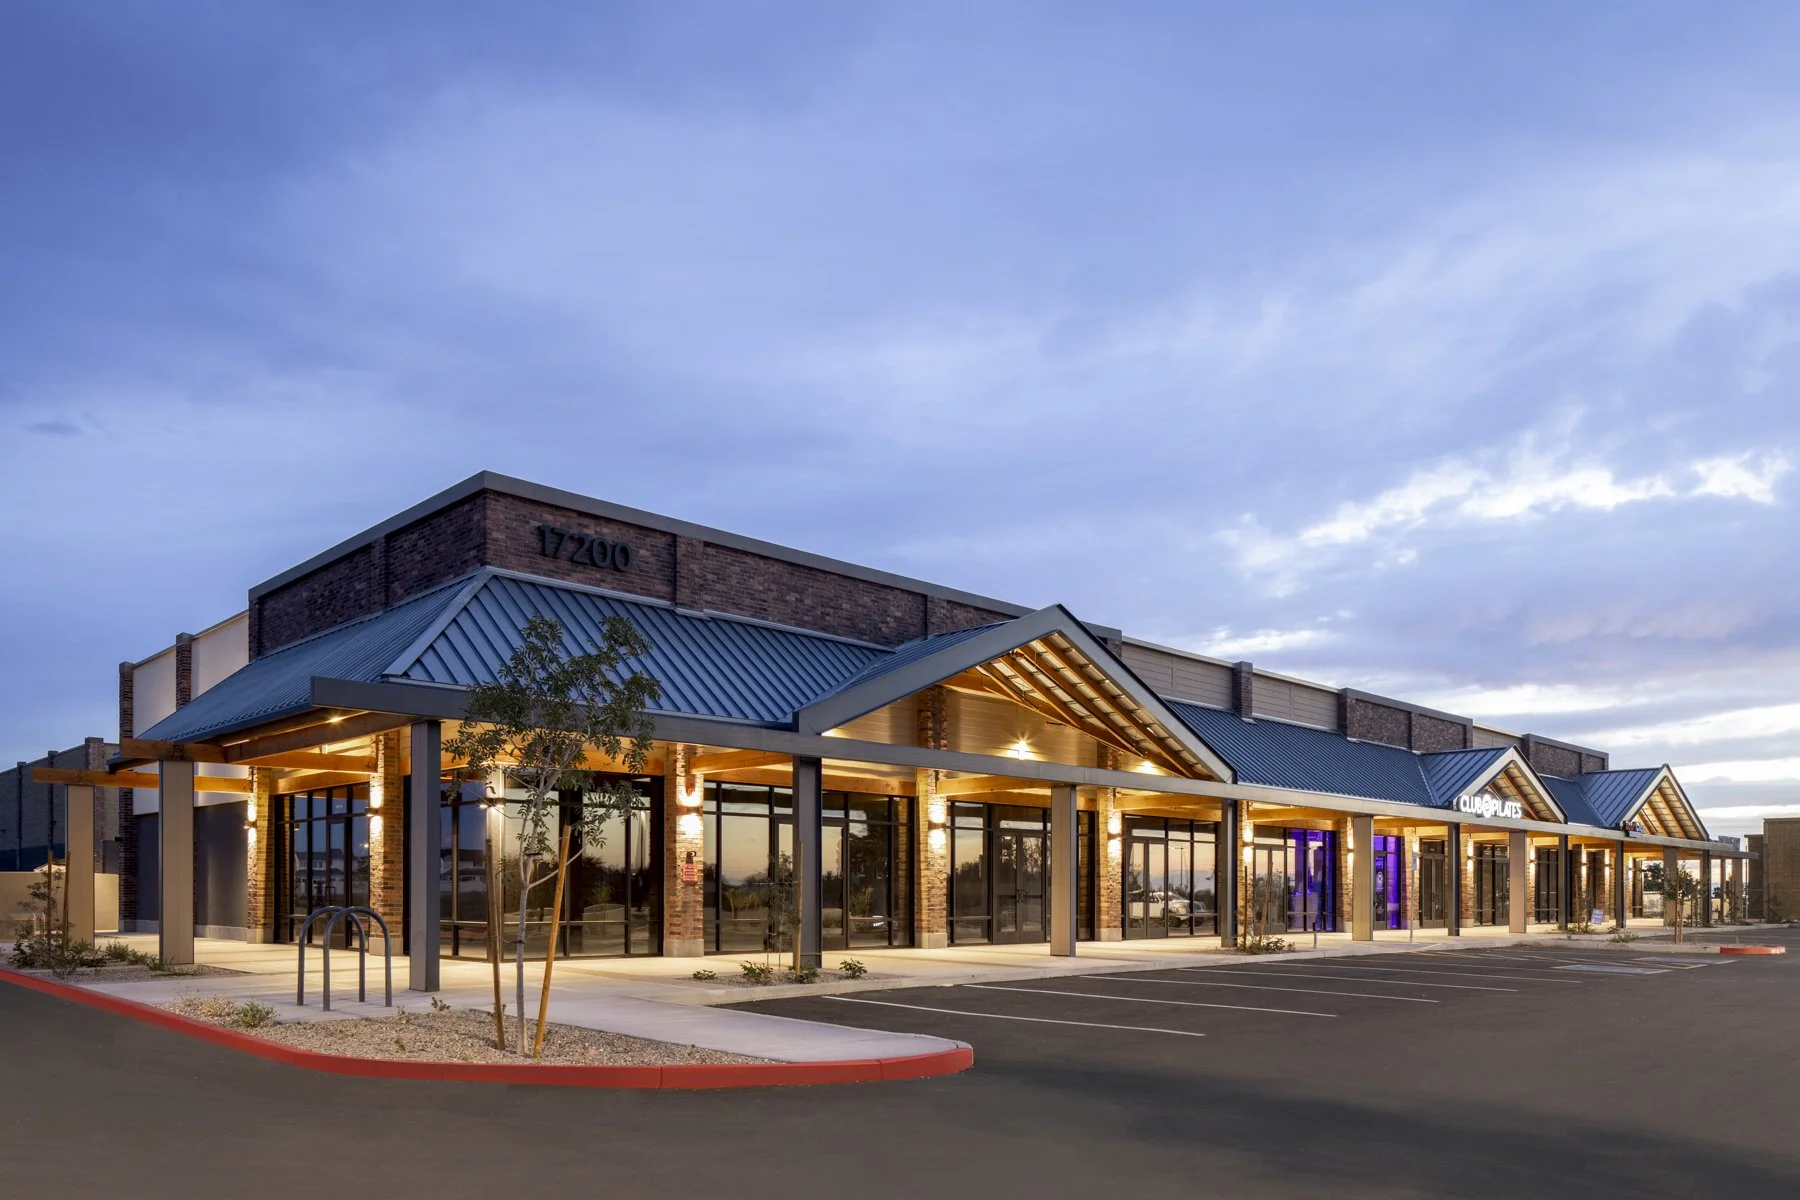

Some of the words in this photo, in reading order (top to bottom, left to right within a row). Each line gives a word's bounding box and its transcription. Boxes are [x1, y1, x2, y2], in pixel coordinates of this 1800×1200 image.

[537, 523, 634, 572] 17200
[1459, 794, 1483, 814] CLUB
[1492, 798, 1522, 819] PILATES
